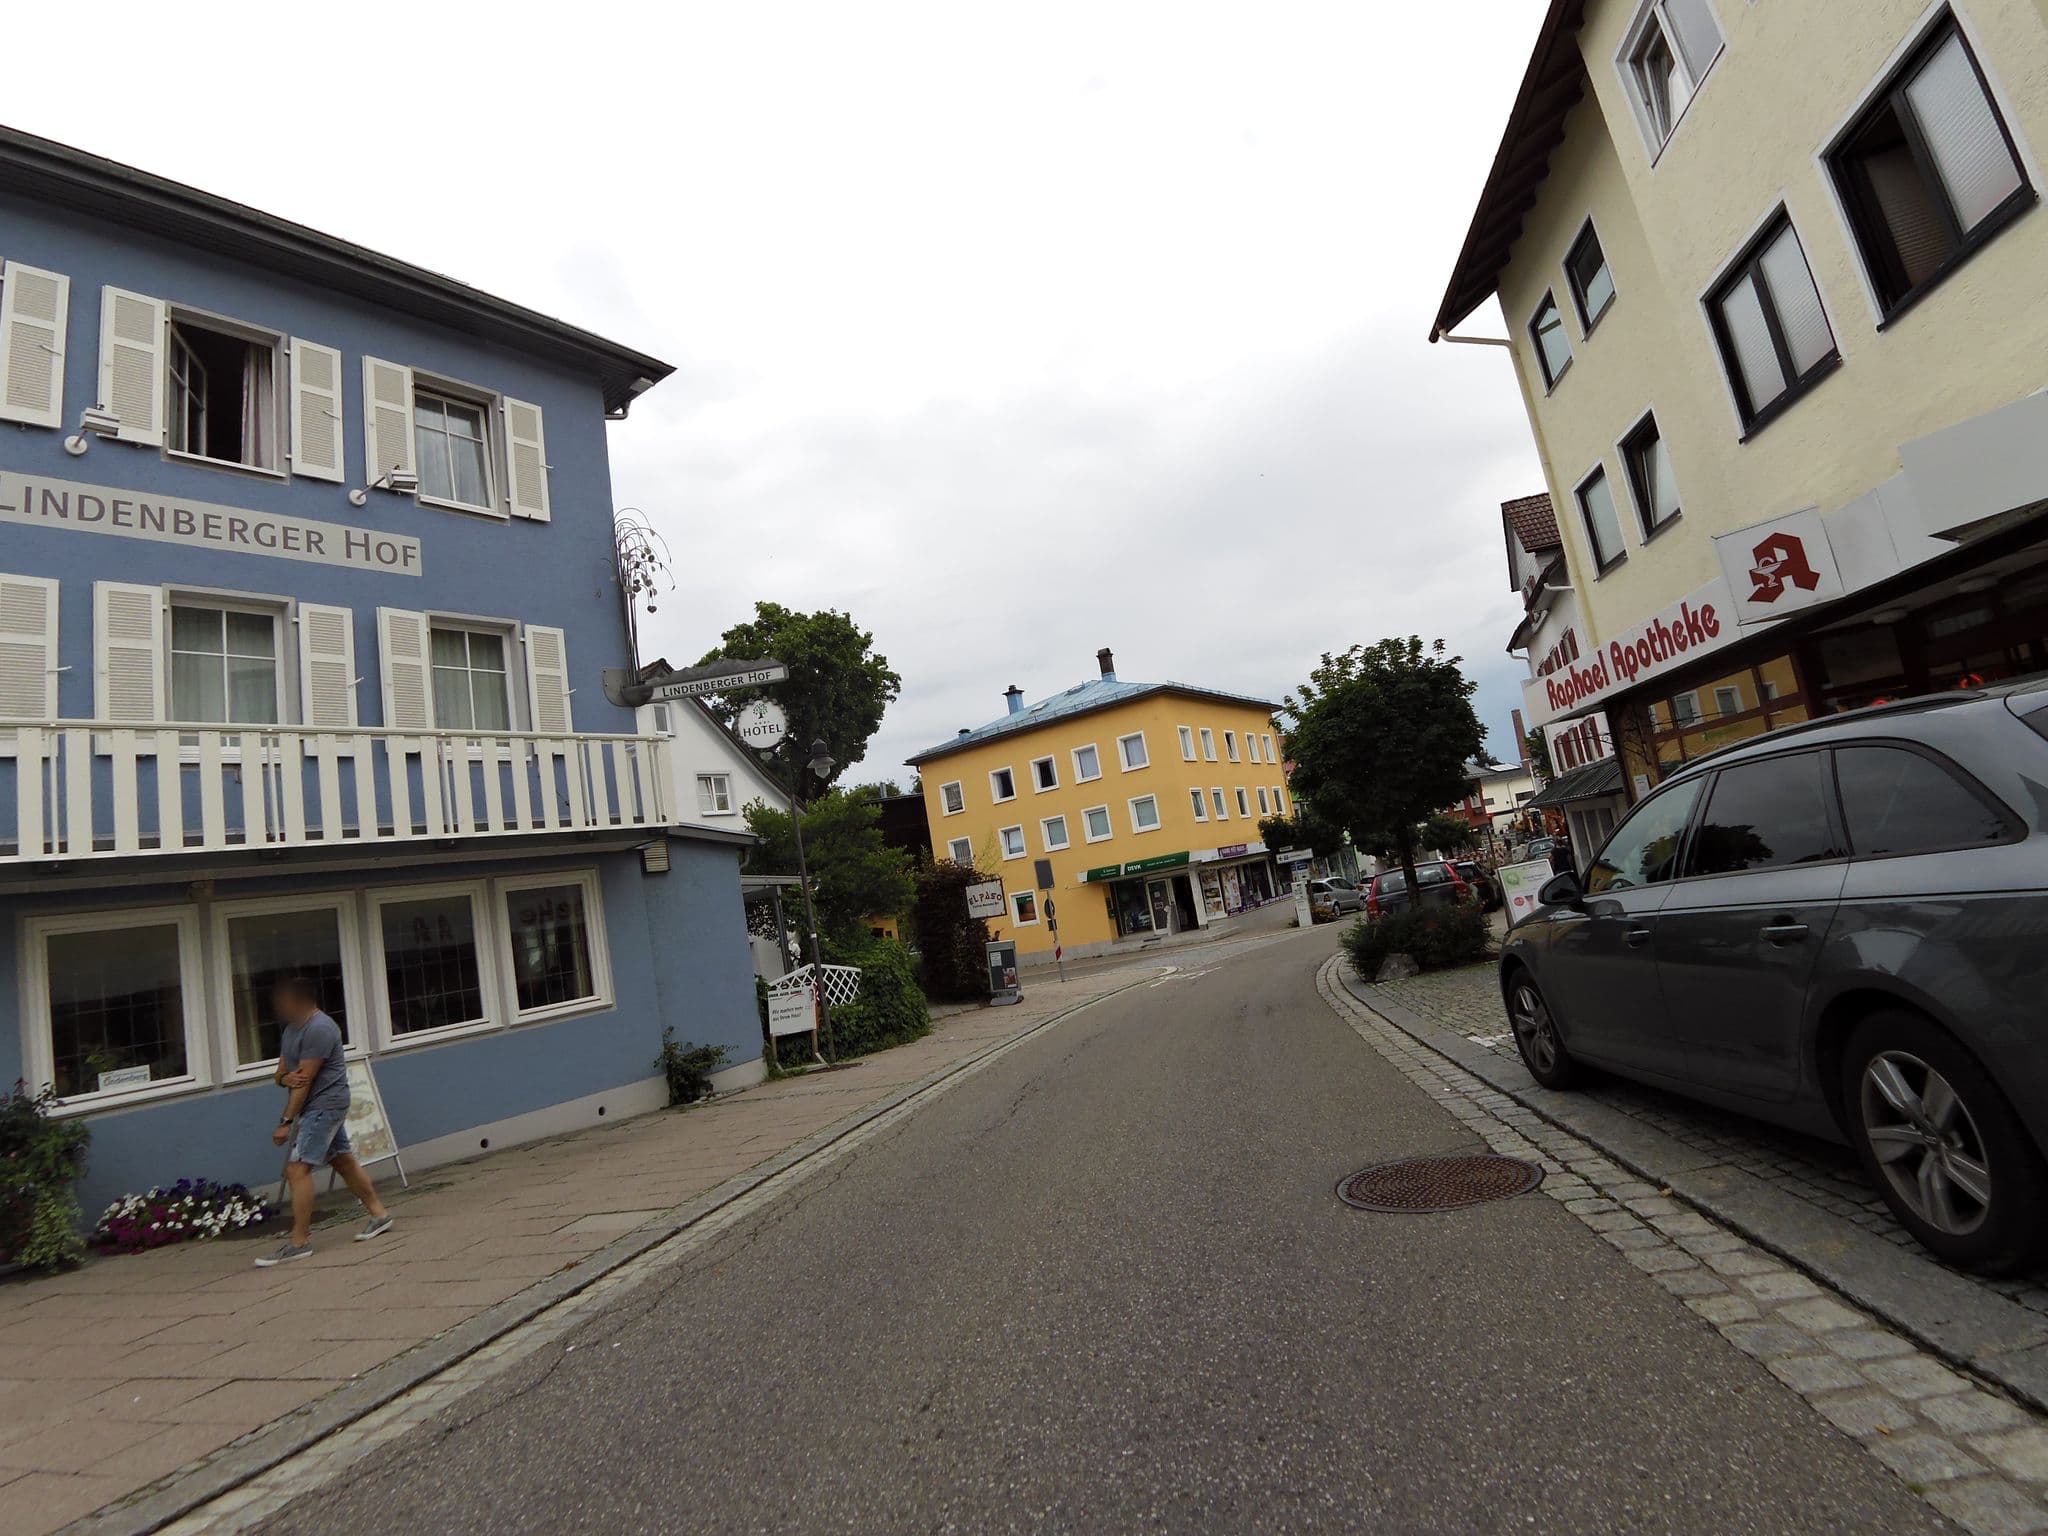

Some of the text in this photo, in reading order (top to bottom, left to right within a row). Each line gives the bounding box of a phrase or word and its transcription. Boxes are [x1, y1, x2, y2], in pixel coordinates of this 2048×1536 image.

[345, 529, 418, 568] HOF
[1546, 602, 1720, 711] Raphael Apotheke
[662, 671, 771, 697] LINDENBERGER HOF
[743, 724, 782, 737] HOTEL
[1127, 864, 1142, 872] DEVK
